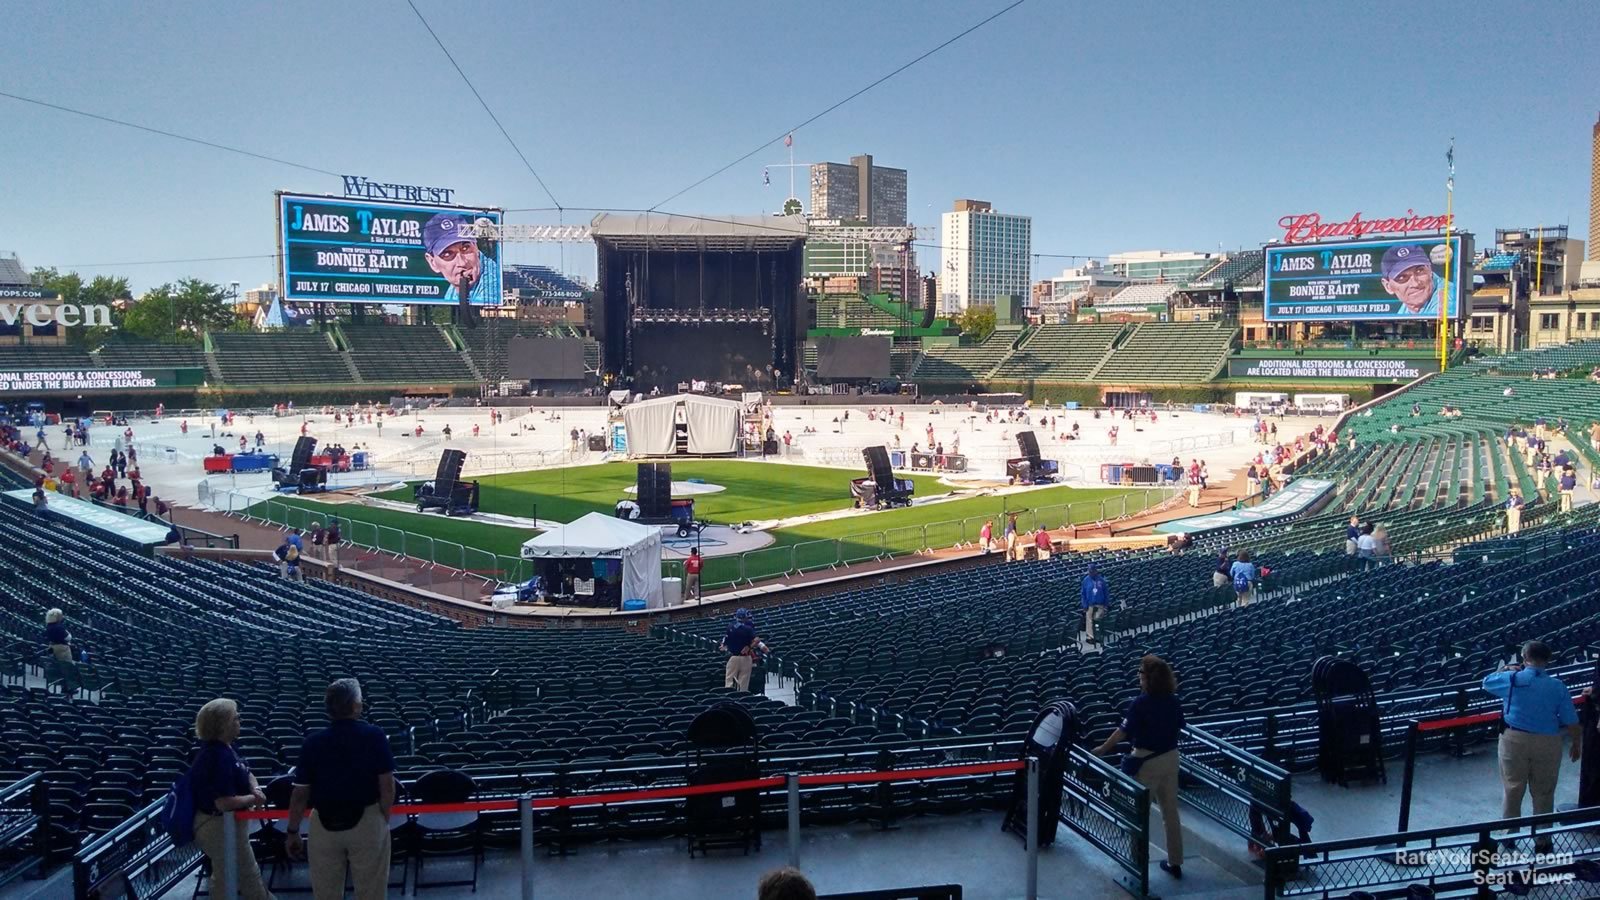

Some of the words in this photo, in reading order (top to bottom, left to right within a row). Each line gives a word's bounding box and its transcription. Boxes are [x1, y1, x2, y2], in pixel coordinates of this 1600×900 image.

[341, 174, 454, 204] WINTRUST
[291, 206, 349, 233] JAMES
[357, 210, 421, 238] TAYLOR
[1278, 209, 1454, 243] Budweiser
[317, 251, 365, 267] BONNIE
[369, 254, 408, 269] RAITT
[1273, 254, 1315, 272] JAMES
[1321, 251, 1372, 270] TAYLOR
[296, 281, 318, 291] JULY
[320, 282, 329, 292] 17
[335, 282, 370, 293] CHICAGO
[375, 284, 414, 294] WRIGLEY
[415, 285, 439, 295] FIELD
[1289, 285, 1325, 297] BONNIE
[1328, 283, 1360, 295] RAITT
[1278, 306, 1294, 314] JULY
[1295, 306, 1301, 314] 17
[1305, 305, 1332, 314] CHICAGO
[1336, 304, 1368, 313] WRIGLEY
[1369, 304, 1390, 312] FIELD
[1259, 360, 1300, 368] ADDITIONAL
[1302, 360, 1344, 368] RESTROOMS
[1346, 360, 1352, 368] &
[1354, 360, 1405, 369] CONCESSIONS
[24, 371, 75, 381] RESTROOMS
[77, 371, 84, 380] &
[86, 370, 142, 380] CONCESSIONS
[1247, 368, 1260, 376] ARE
[1261, 368, 1291, 376] LOCATED
[1293, 368, 1317, 376] UNDER
[1318, 368, 1332, 376] THE
[1333, 368, 1375, 377] BUDWEISER
[1377, 368, 1419, 378] BLEACHERS
[12, 380, 42, 390] UNDER
[44, 380, 61, 389] THE
[63, 379, 110, 389] BUDWEISER
[112, 378, 156, 388] BLEACHERS
